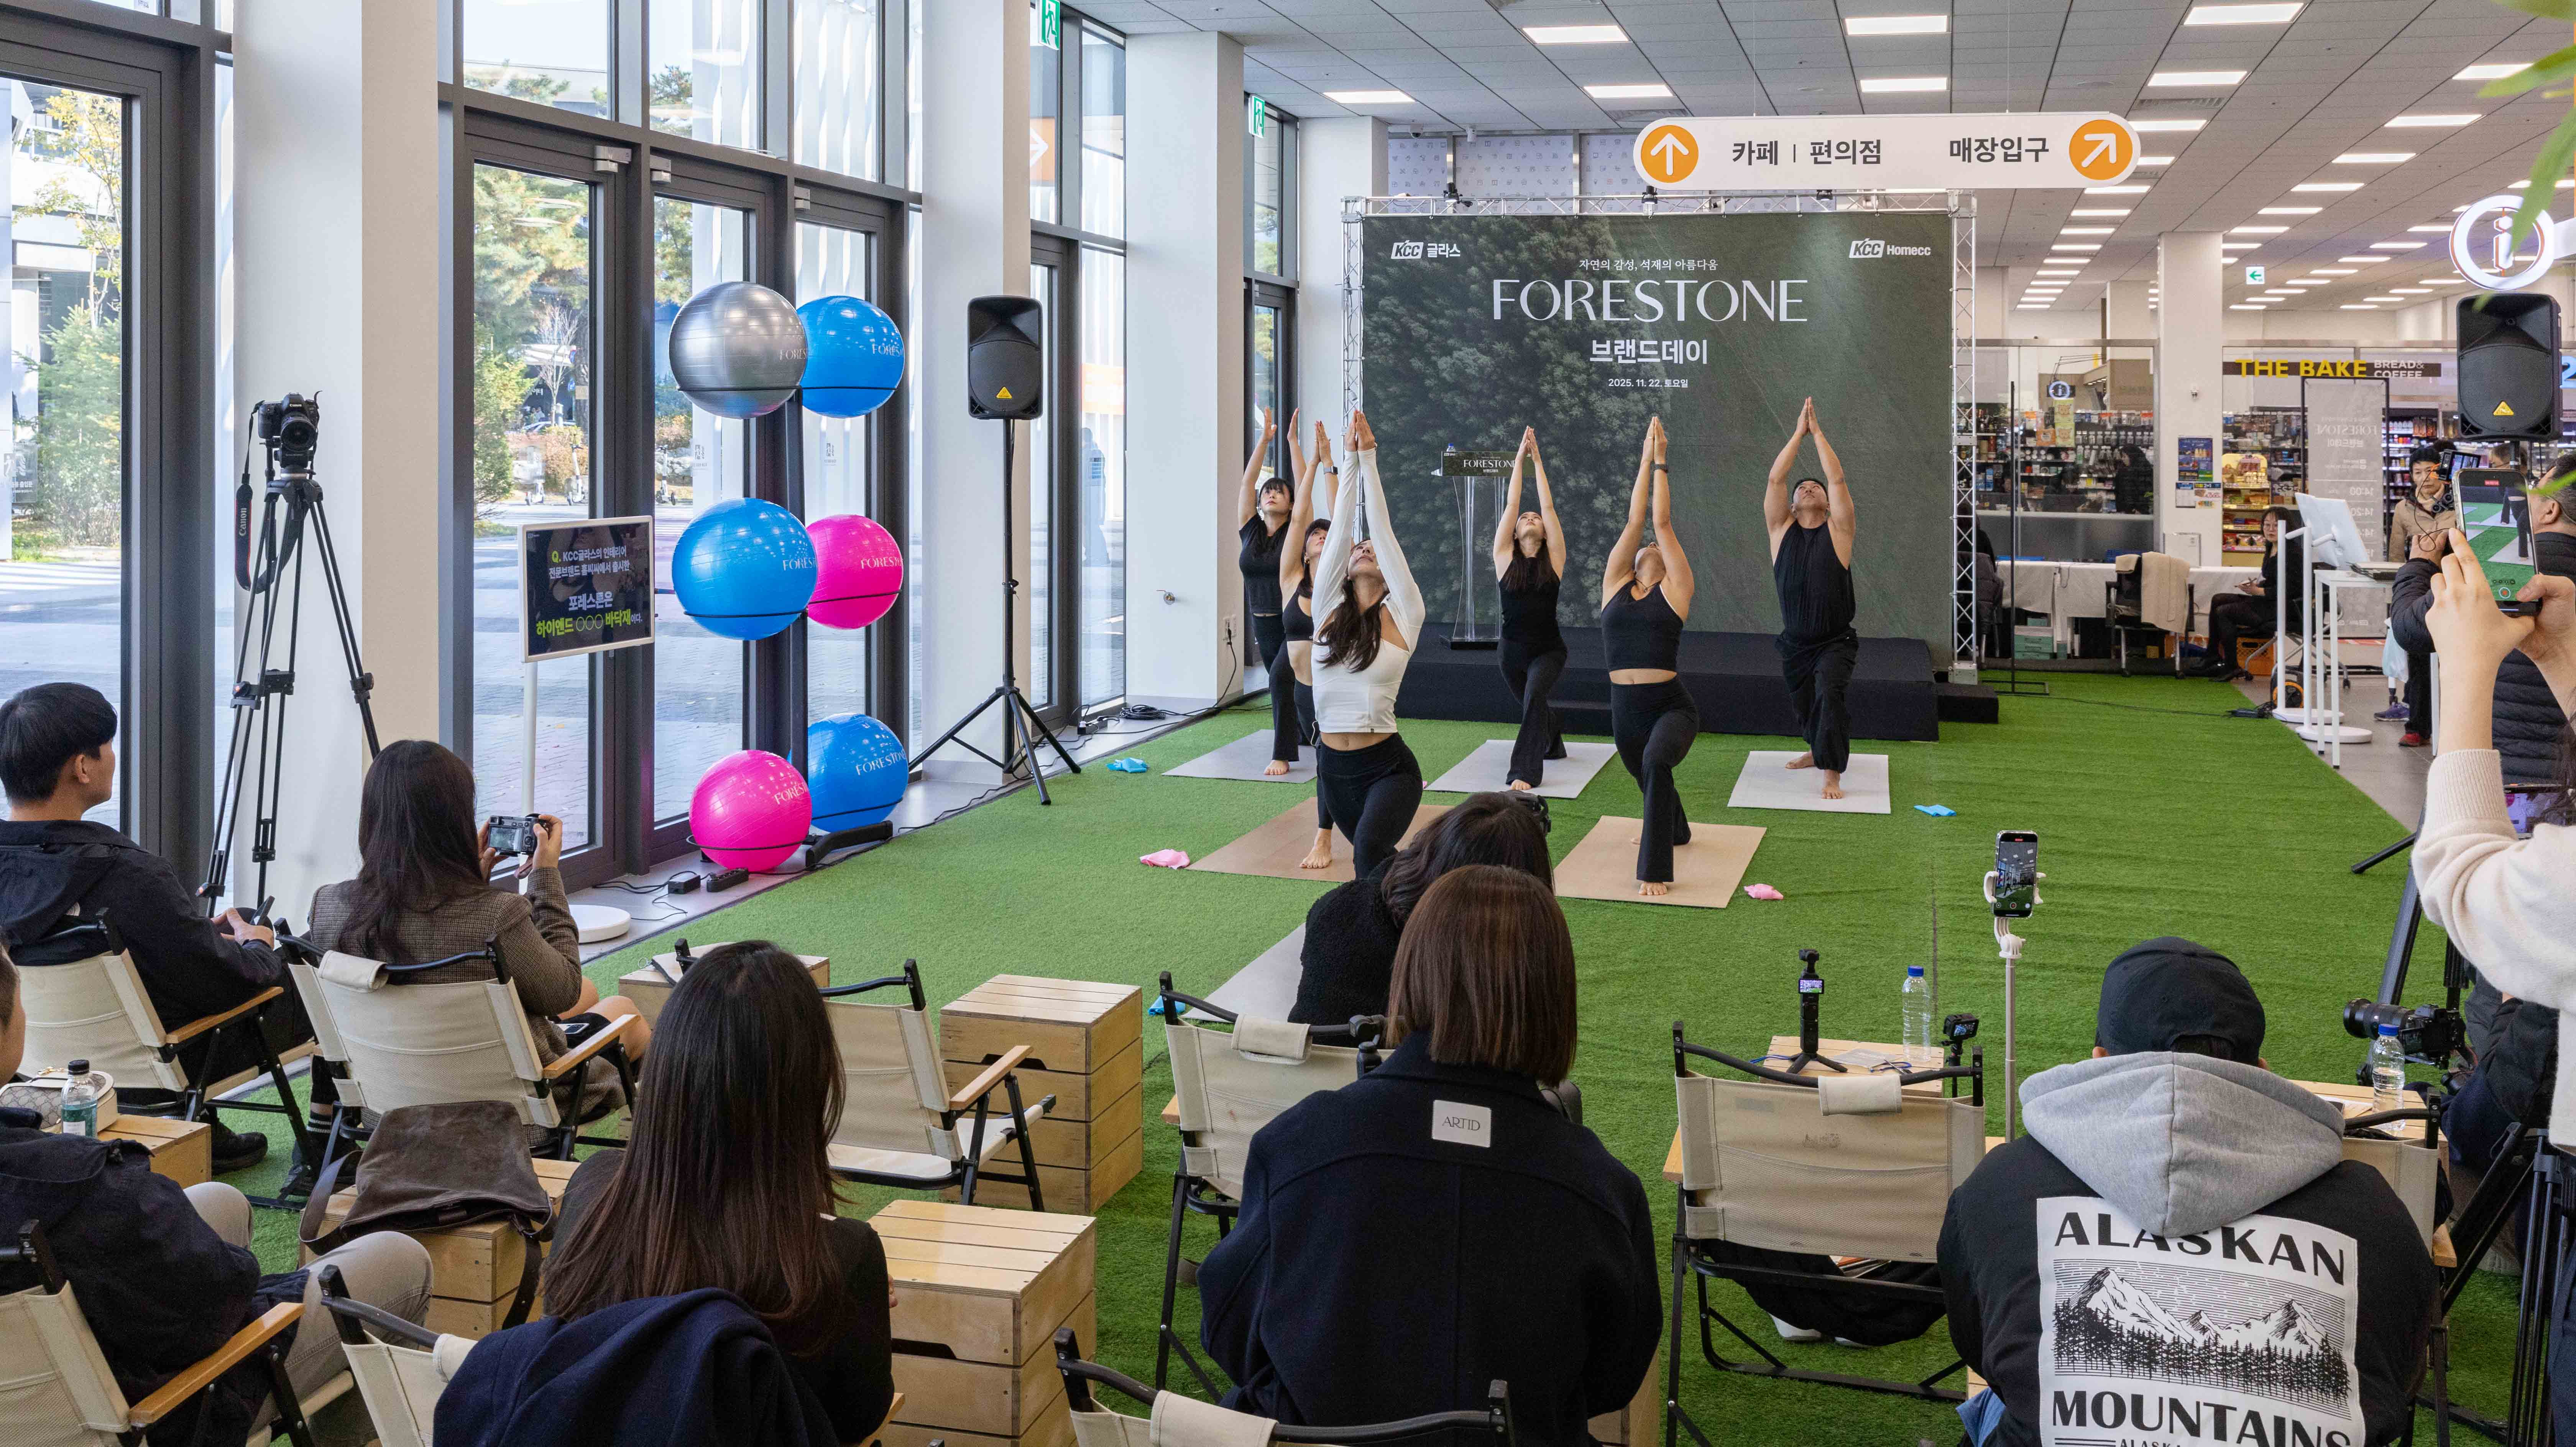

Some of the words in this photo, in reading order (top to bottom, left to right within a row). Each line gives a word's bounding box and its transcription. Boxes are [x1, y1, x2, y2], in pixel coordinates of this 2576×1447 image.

[1732, 140, 1779, 166] 카페
[1809, 139, 1881, 164] 편의점
[1949, 137, 2050, 163] 매장입구
[1392, 240, 1423, 258] KCC
[1427, 243, 1461, 258] 글라스
[1851, 238, 1883, 257] KCC
[1886, 245, 1931, 256] Homecc
[1579, 259, 1610, 270] 자연의
[1613, 259, 1638, 271] 감성,
[1640, 259, 1671, 270] 석재의
[1675, 259, 1718, 270] 아름다움
[1493, 279, 1808, 322] FORESTONE
[1589, 339, 1708, 365] 브랜드데이
[2234, 359, 2288, 378] THE
[2300, 359, 2367, 377] BAKE
[1608, 378, 1634, 387] 2025.
[1635, 379, 1646, 387] 11.
[1648, 379, 1663, 387] 22.
[1664, 379, 1688, 388] 토요일
[239, 507, 247, 536] Canon
[551, 550, 561, 563] Q.
[562, 548, 602, 562] KCC글라스의
[603, 545, 627, 559] 인테리어
[568, 590, 614, 611] 포레스톤은
[536, 617, 574, 638] 하이엔드
[1442, 1116, 1480, 1131] ARTID
[2054, 1212, 2345, 1286] ALASKAN
